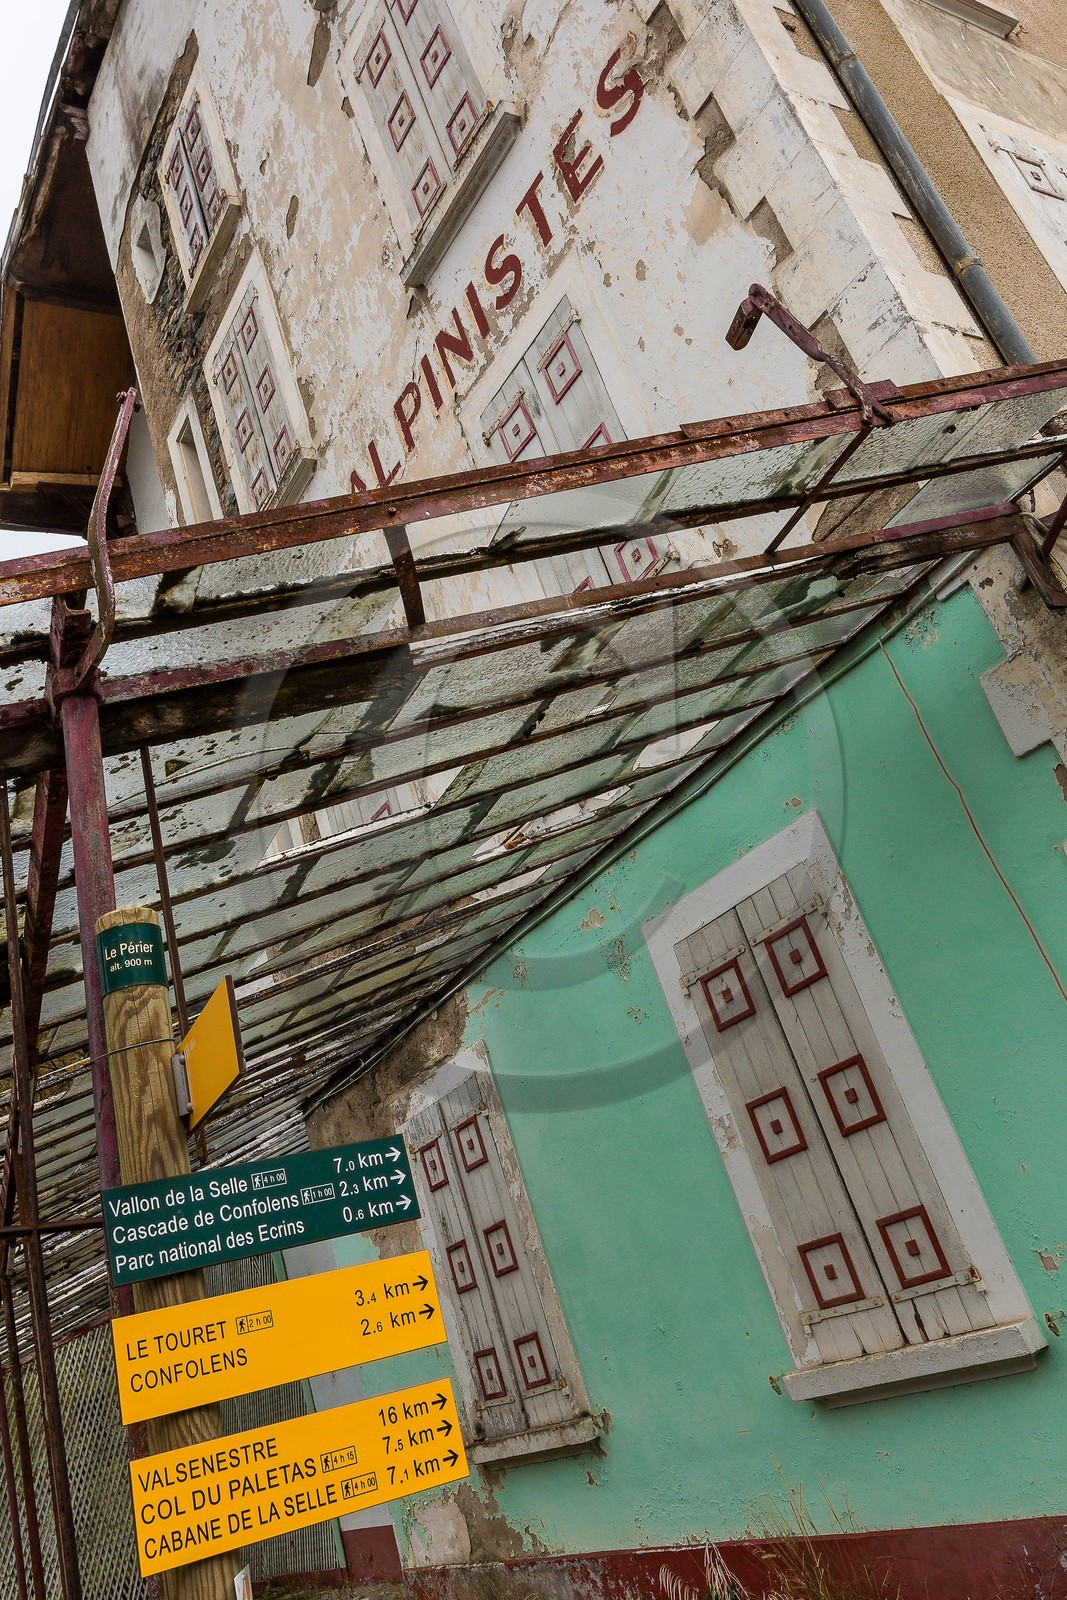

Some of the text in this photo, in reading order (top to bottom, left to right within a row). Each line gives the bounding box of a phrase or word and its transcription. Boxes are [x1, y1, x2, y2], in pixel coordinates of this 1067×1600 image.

[104, 941, 153, 961] Le Périer
[110, 962, 123, 972] alt.
[124, 958, 142, 968] 900
[109, 1196, 160, 1218] Vallon
[165, 1189, 186, 1207] de
[189, 1186, 205, 1202] la
[209, 1177, 248, 1198] Selle
[333, 1158, 355, 1174] 7.0
[357, 1152, 384, 1169] km
[113, 1215, 189, 1244] Cascade
[194, 1210, 215, 1228] de
[219, 1194, 300, 1222] Confolens
[339, 1181, 360, 1197] 2.3
[363, 1175, 389, 1192] km
[115, 1200, 394, 1274] Parc national des Ecrins 0.6 km
[126, 1339, 149, 1361] LE
[153, 1321, 227, 1354] TOURET
[354, 1289, 377, 1307] 3.4
[383, 1282, 410, 1299] km
[130, 1310, 416, 1393] CONFOLENS 2.6 km
[138, 1401, 430, 1493] VALSENESTRE 16 km
[141, 1496, 187, 1525] COL
[191, 1484, 221, 1511] DU
[228, 1457, 317, 1500] PALETAS
[382, 1435, 404, 1455] 7.5
[408, 1428, 435, 1447] km
[144, 1517, 223, 1559] CABANE
[227, 1509, 253, 1535] DE
[257, 1501, 281, 1526] LA
[283, 1484, 338, 1517] SELLE
[386, 1466, 410, 1485] 7.1
[413, 1458, 441, 1478] km
